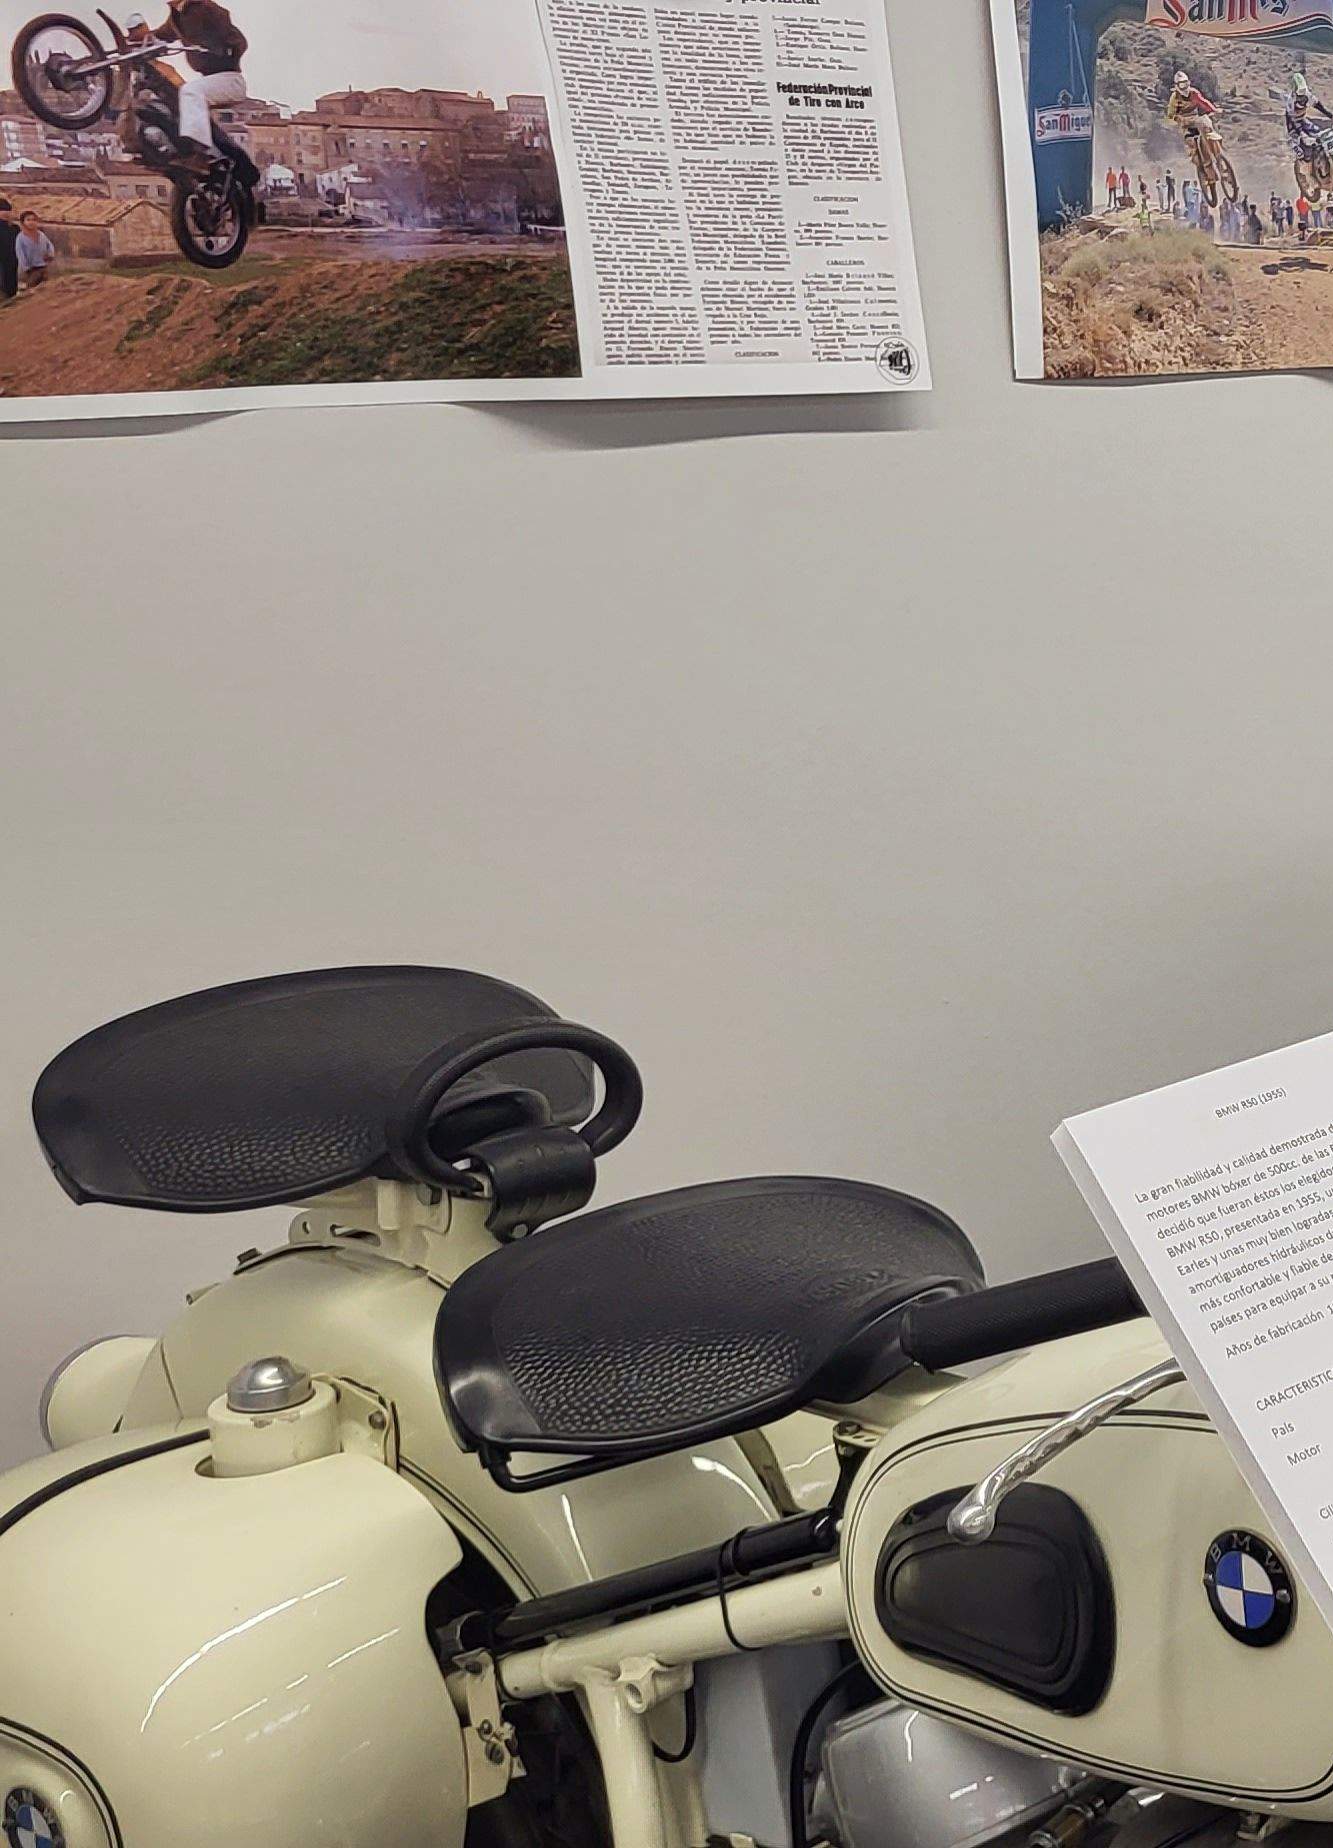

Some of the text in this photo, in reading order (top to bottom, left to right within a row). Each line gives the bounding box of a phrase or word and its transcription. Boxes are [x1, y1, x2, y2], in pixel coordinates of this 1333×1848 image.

[776, 81, 873, 98] Federación Provincial
[788, 96, 865, 110] de Tiro con Arco
[1214, 1087, 1287, 1119] BMW R50 (1955)
[1134, 1192, 1149, 1204] La
[1149, 1183, 1175, 1201] gran
[1174, 1163, 1224, 1189] fiabilidad
[1222, 1162, 1232, 1174] y
[1231, 1147, 1269, 1169] calidad
[1269, 1127, 1328, 1155] demostrada
[1145, 1199, 1192, 1222] motores
[1190, 1185, 1221, 1205] BMW
[1220, 1176, 1251, 1194] bóxer
[1252, 1170, 1268, 1183] de
[1266, 1160, 1301, 1177] 500cc.
[1300, 1153, 1315, 1165] de
[1313, 1148, 1331, 1160] las
[1156, 1216, 1196, 1240] decidió
[1196, 1210, 1218, 1227] que
[1216, 1198, 1253, 1217] fueran
[1253, 1187, 1281, 1204] éstos
[1279, 1181, 1297, 1194] los
[1165, 1237, 1197, 1258] BMW
[1197, 1229, 1224, 1247] R50,
[1223, 1208, 1281, 1239] presentada
[1281, 1203, 1297, 1215] en
[1295, 1191, 1326, 1209] 1955,
[1188, 1256, 1270, 1294] amortiguadores
[1269, 1235, 1325, 1262] hidráulicos
[1209, 1311, 1244, 1334] países
[1243, 1301, 1268, 1320] para
[1268, 1284, 1308, 1307] equipar
[1308, 1281, 1317, 1291] a
[1316, 1275, 1331, 1288] su
[1225, 1340, 1253, 1359] Años
[1253, 1333, 1269, 1346] de
[1267, 1310, 1325, 1340] fabricación
[1270, 1421, 1295, 1439] País
[1286, 1444, 1321, 1466] Motor
[1209, 1532, 1284, 1576] BMW
